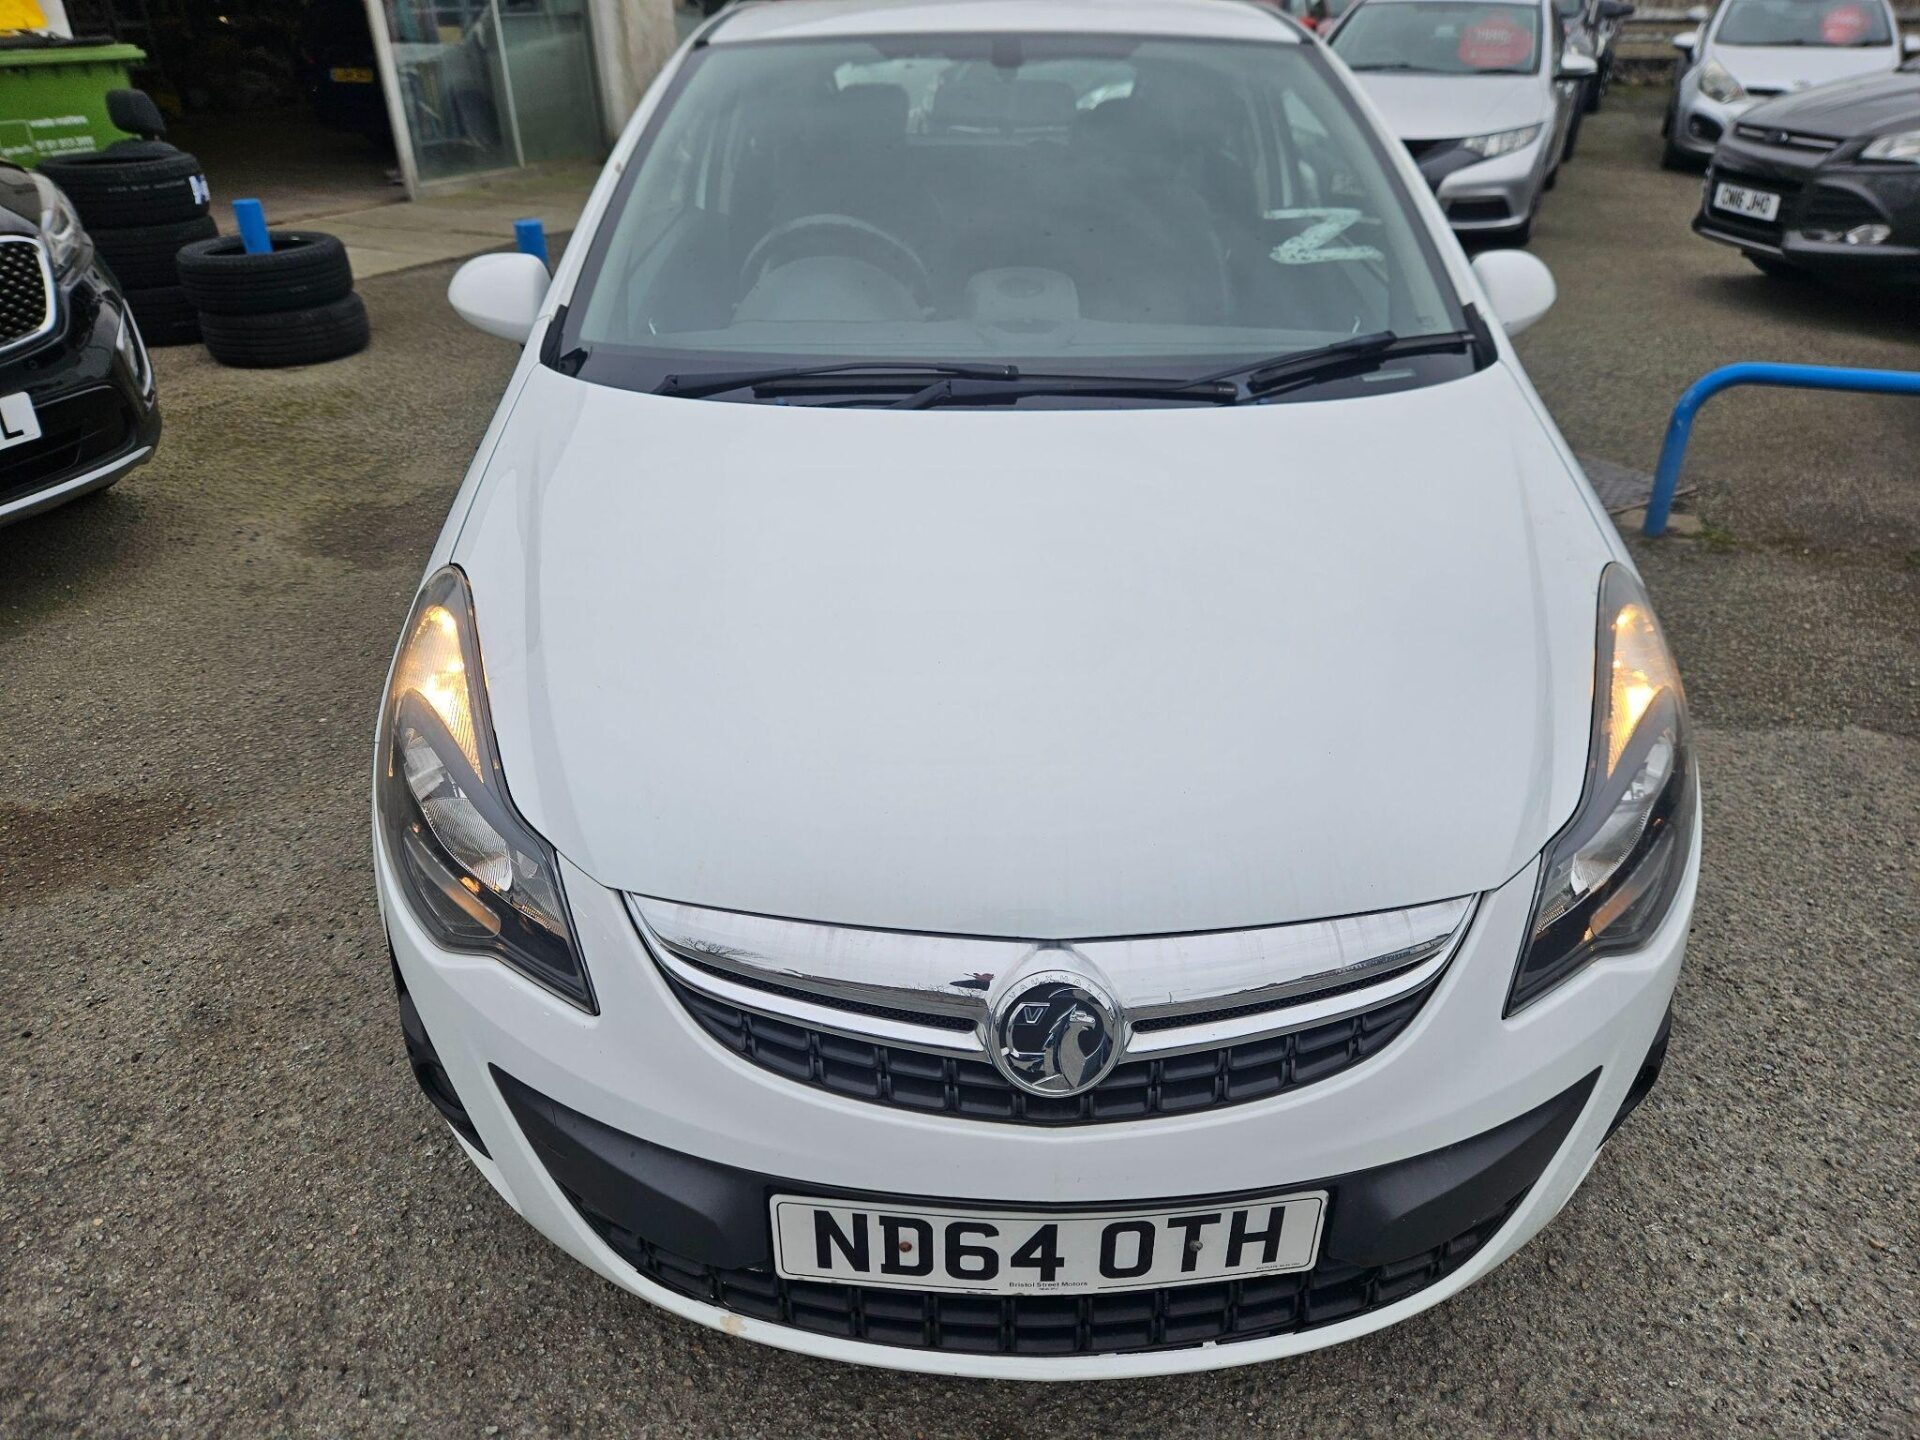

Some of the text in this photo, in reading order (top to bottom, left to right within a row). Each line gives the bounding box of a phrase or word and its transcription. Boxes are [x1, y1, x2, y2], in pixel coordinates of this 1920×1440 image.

[1008, 974, 1104, 1001] VAUXHALL
[813, 1206, 1286, 1282] ND64 OTH
